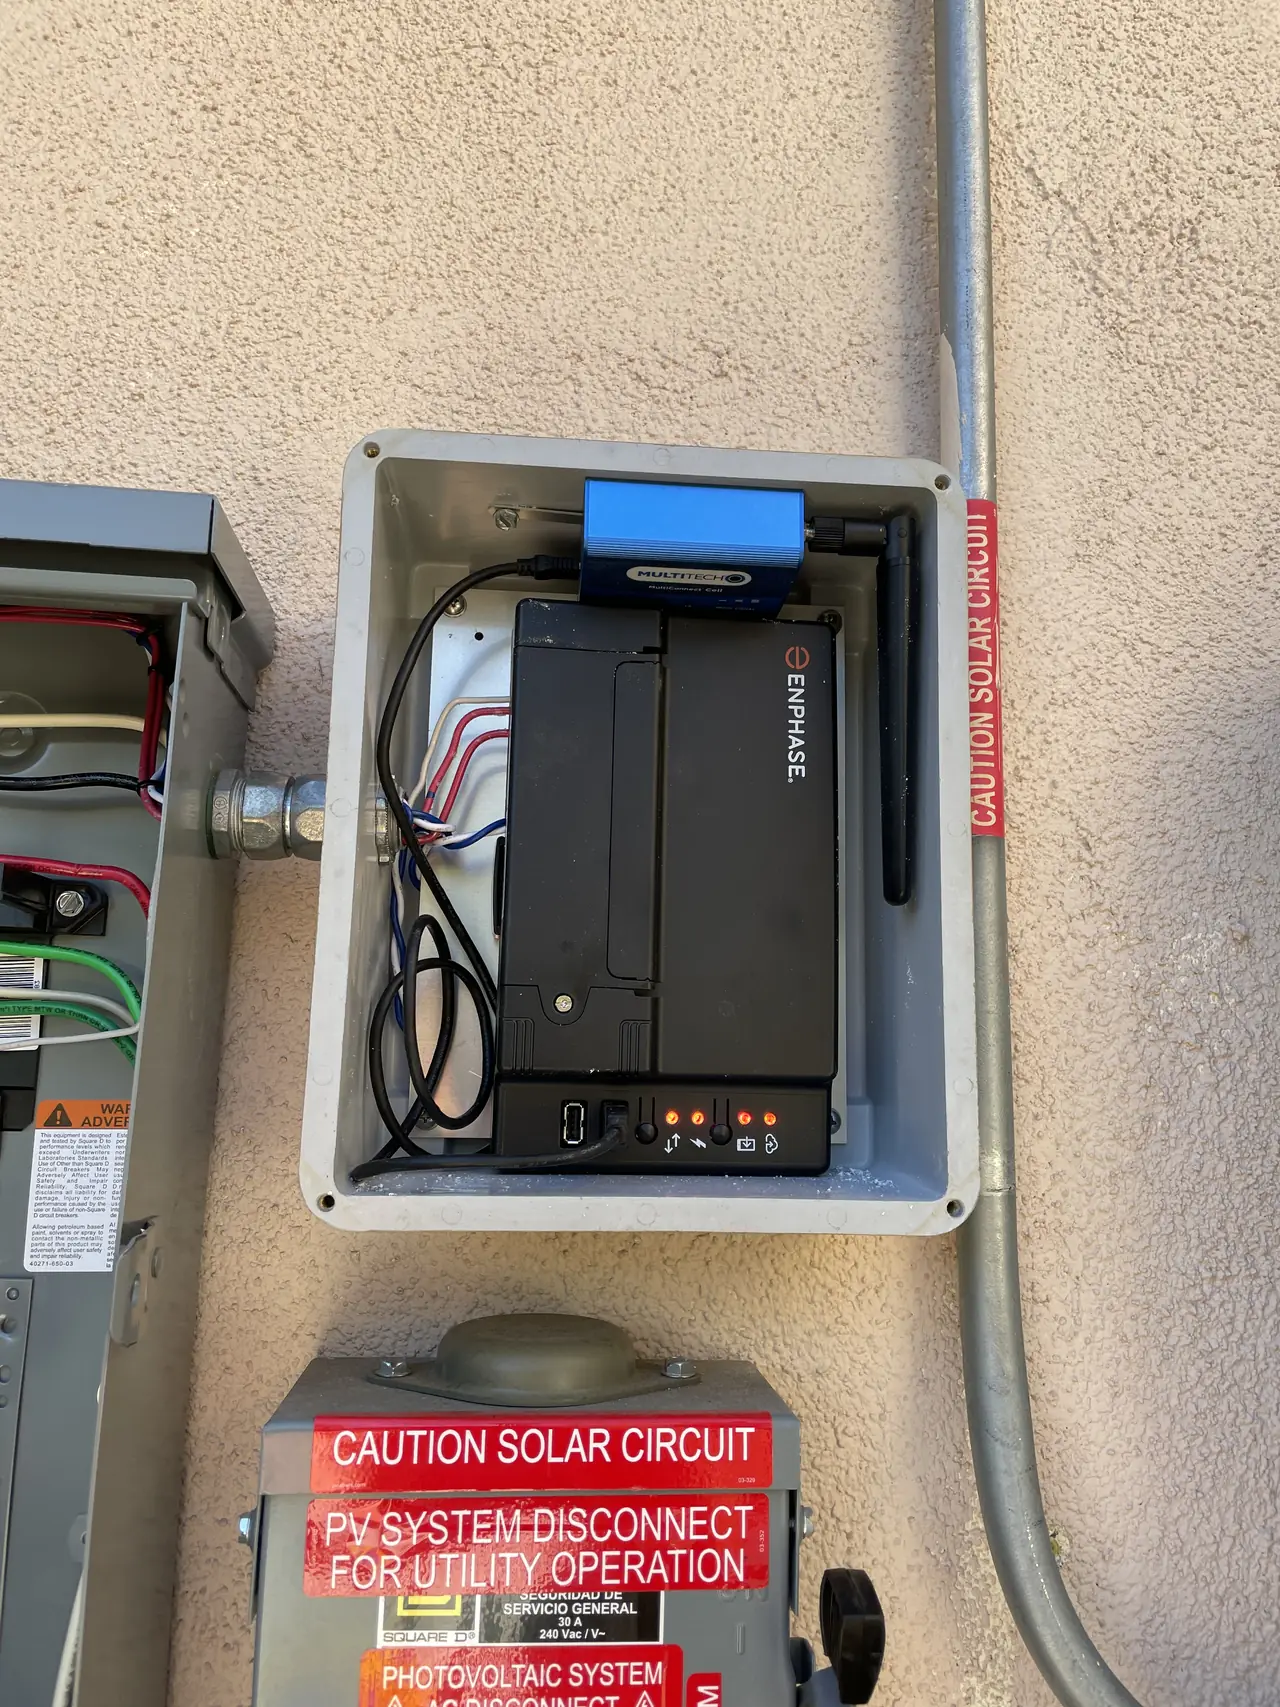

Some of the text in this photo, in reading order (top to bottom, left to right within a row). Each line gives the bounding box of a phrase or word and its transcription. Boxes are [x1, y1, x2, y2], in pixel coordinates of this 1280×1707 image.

[637, 570, 724, 581] MULTITECH
[968, 617, 993, 703] SOLAR
[970, 712, 996, 827] CAUTION
[334, 1427, 755, 1466] CAUTION SOLAR CIRCUIT
[326, 1506, 753, 1547] PV SYSTEM DISCONNECT
[332, 1548, 744, 1590] FOR UTILITY OPERATION
[520, 1592, 623, 1600] SEGURIDAD DE
[504, 1602, 638, 1615] SERVICIO GENERAL
[558, 1617, 582, 1627] 30 A
[383, 1632, 448, 1642] SQUARE
[540, 1629, 559, 1639] 240
[562, 1629, 582, 1639] Vac
[382, 1662, 662, 1689] PHOTOVOLTAIC SYSTEM
